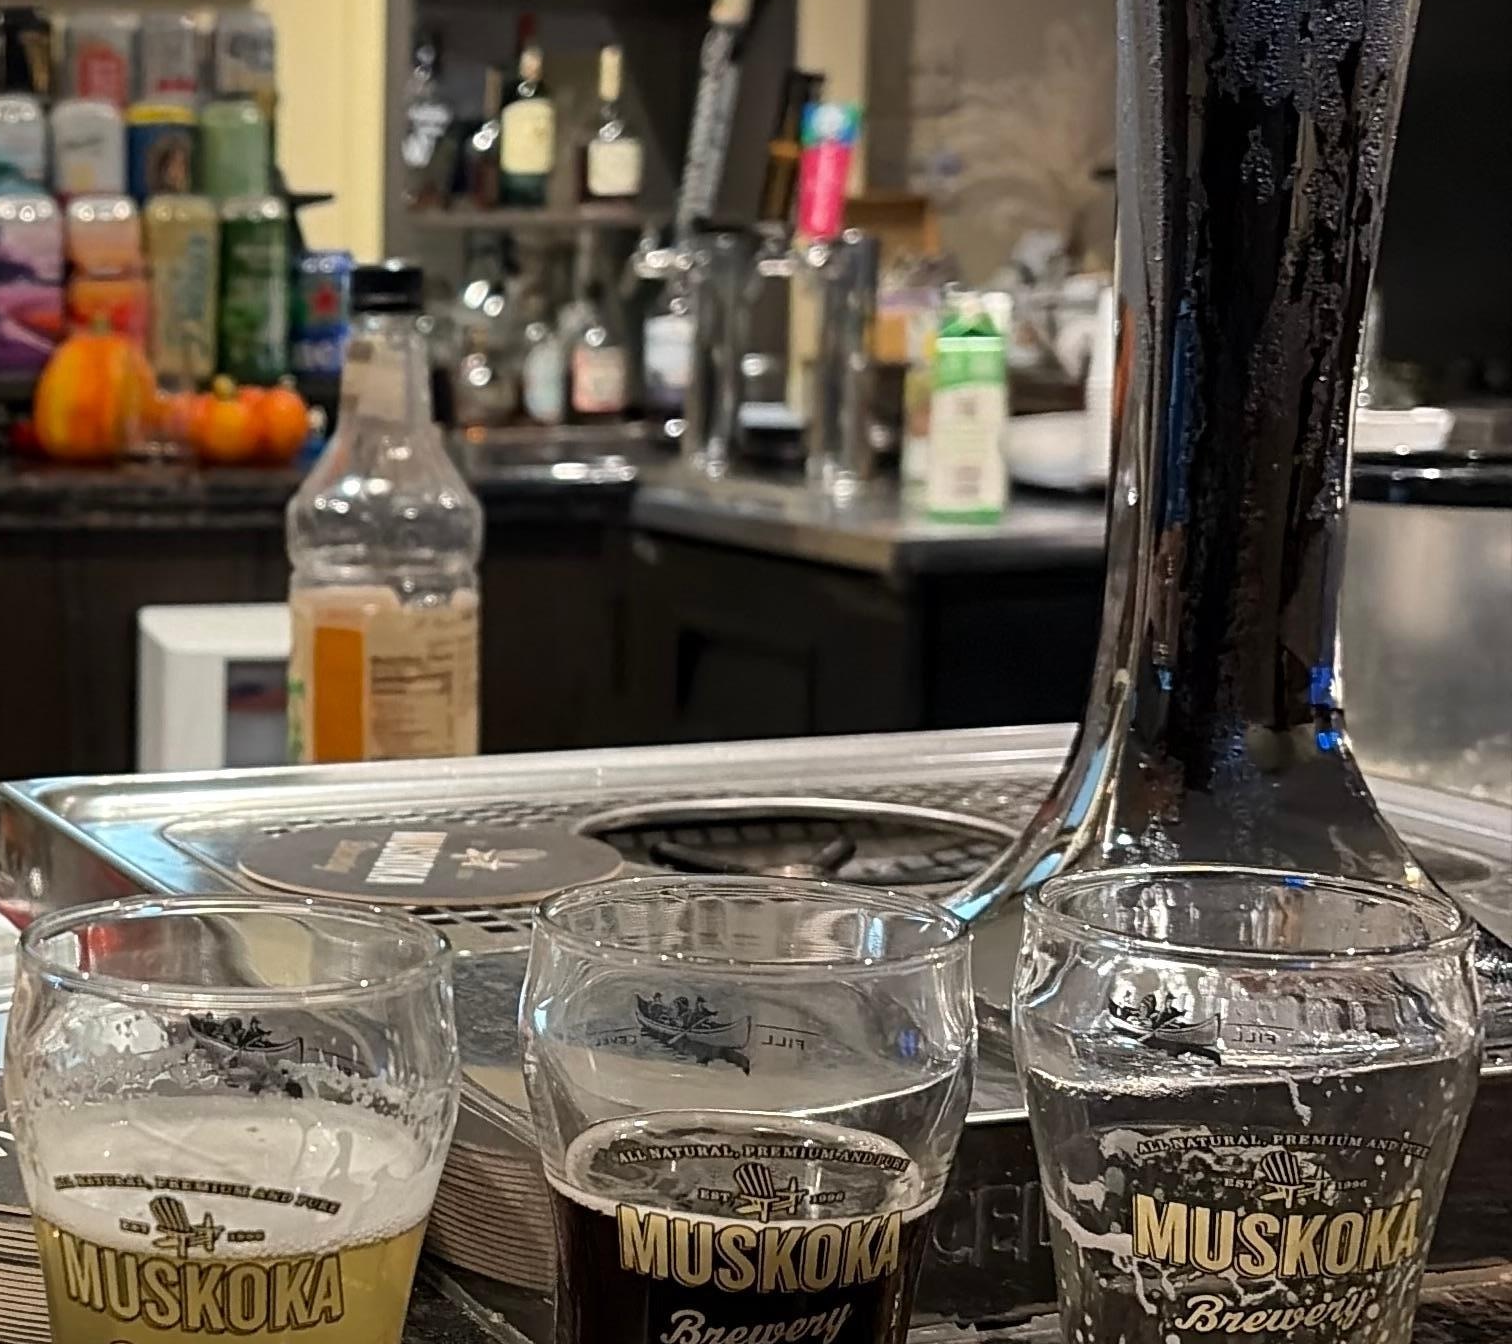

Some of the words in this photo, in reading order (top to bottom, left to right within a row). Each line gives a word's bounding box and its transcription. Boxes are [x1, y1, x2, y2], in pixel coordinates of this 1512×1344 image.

[617, 1148, 647, 1164] ALL
[743, 1144, 836, 1162] PREMIUM
[838, 1150, 878, 1166] AND
[1138, 1138, 1170, 1154] ALL
[1272, 1133, 1364, 1148] PREMIUM
[1365, 1137, 1400, 1153] AND
[155, 1176, 252, 1197] PREMIUM
[253, 1187, 293, 1204] AND
[295, 1193, 341, 1215] PURE
[697, 1188, 731, 1204] EST
[1223, 1176, 1256, 1190] EST
[616, 1203, 904, 1294] MUSKOKA
[1132, 1192, 1423, 1279] MUSKOKA
[59, 1230, 345, 1337] MUSKOKA
[1174, 1287, 1373, 1335] Brewery
